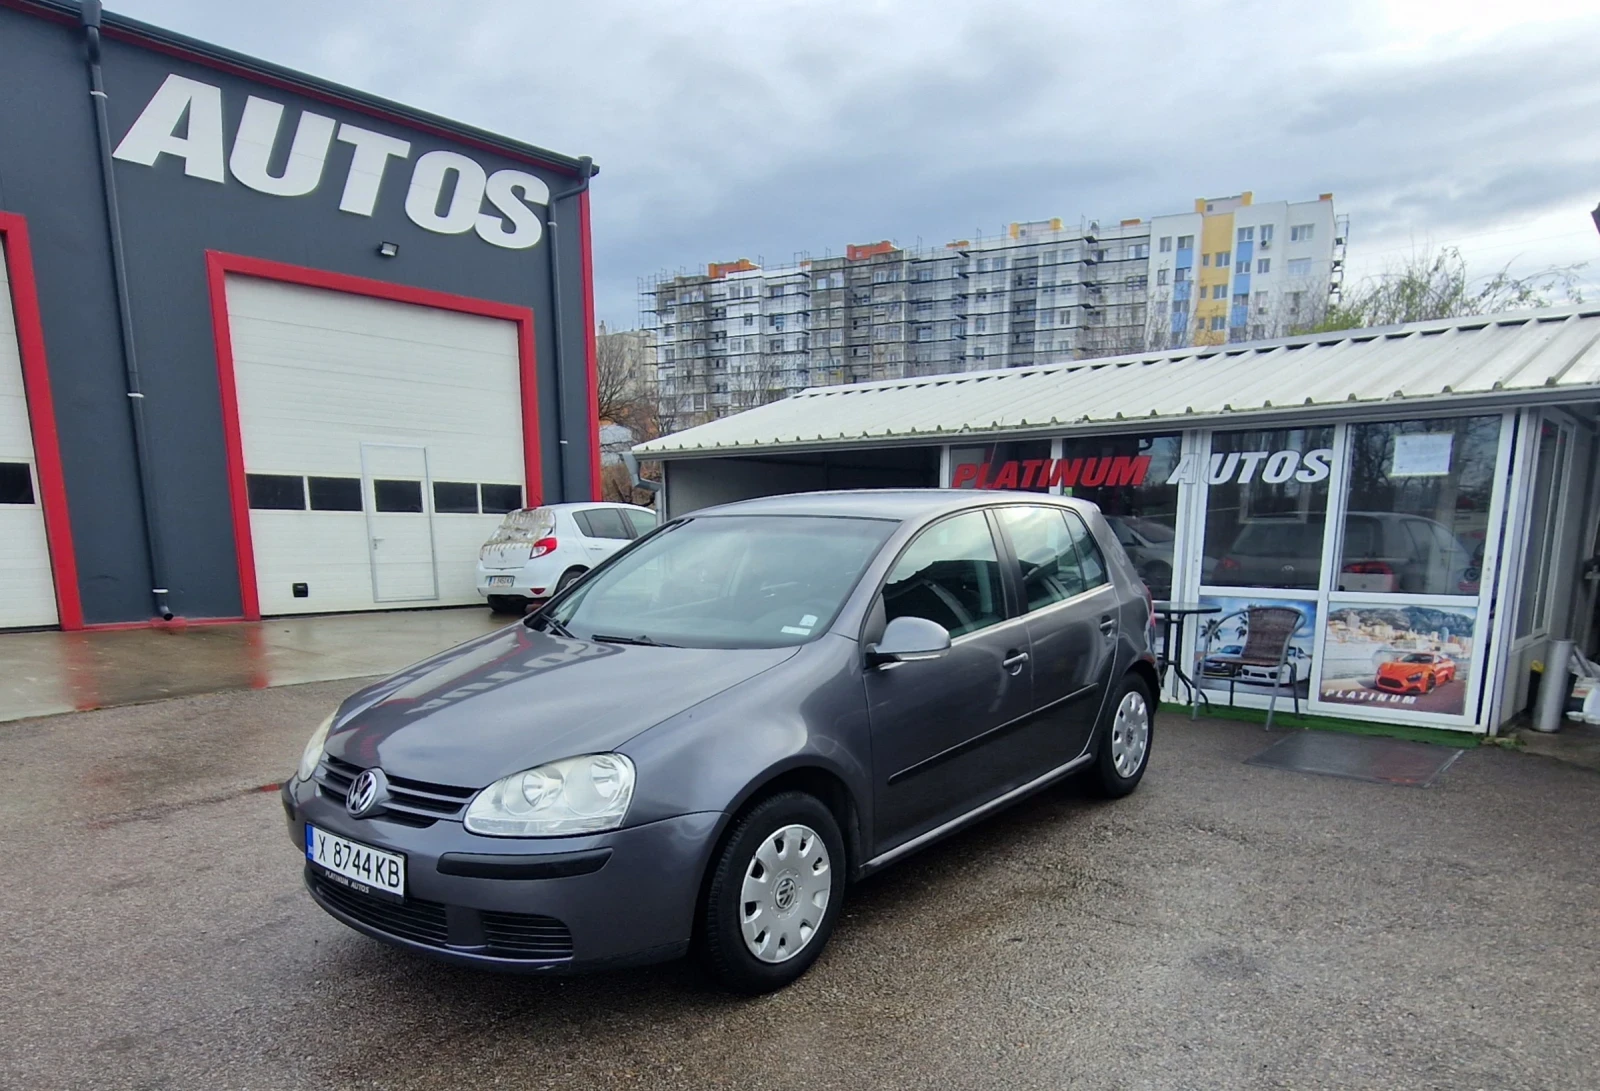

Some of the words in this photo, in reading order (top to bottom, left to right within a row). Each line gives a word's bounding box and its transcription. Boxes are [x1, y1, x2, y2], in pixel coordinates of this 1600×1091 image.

[112, 73, 551, 249] AUTOS
[951, 455, 1153, 489] PLATINUM
[1165, 448, 1333, 485] AUTOS
[1324, 688, 1417, 705] PLATINUM
[318, 834, 326, 862] X
[333, 841, 400, 888] 8744KB
[324, 870, 349, 887] PLATINUM
[350, 881, 370, 894] AUTOS
